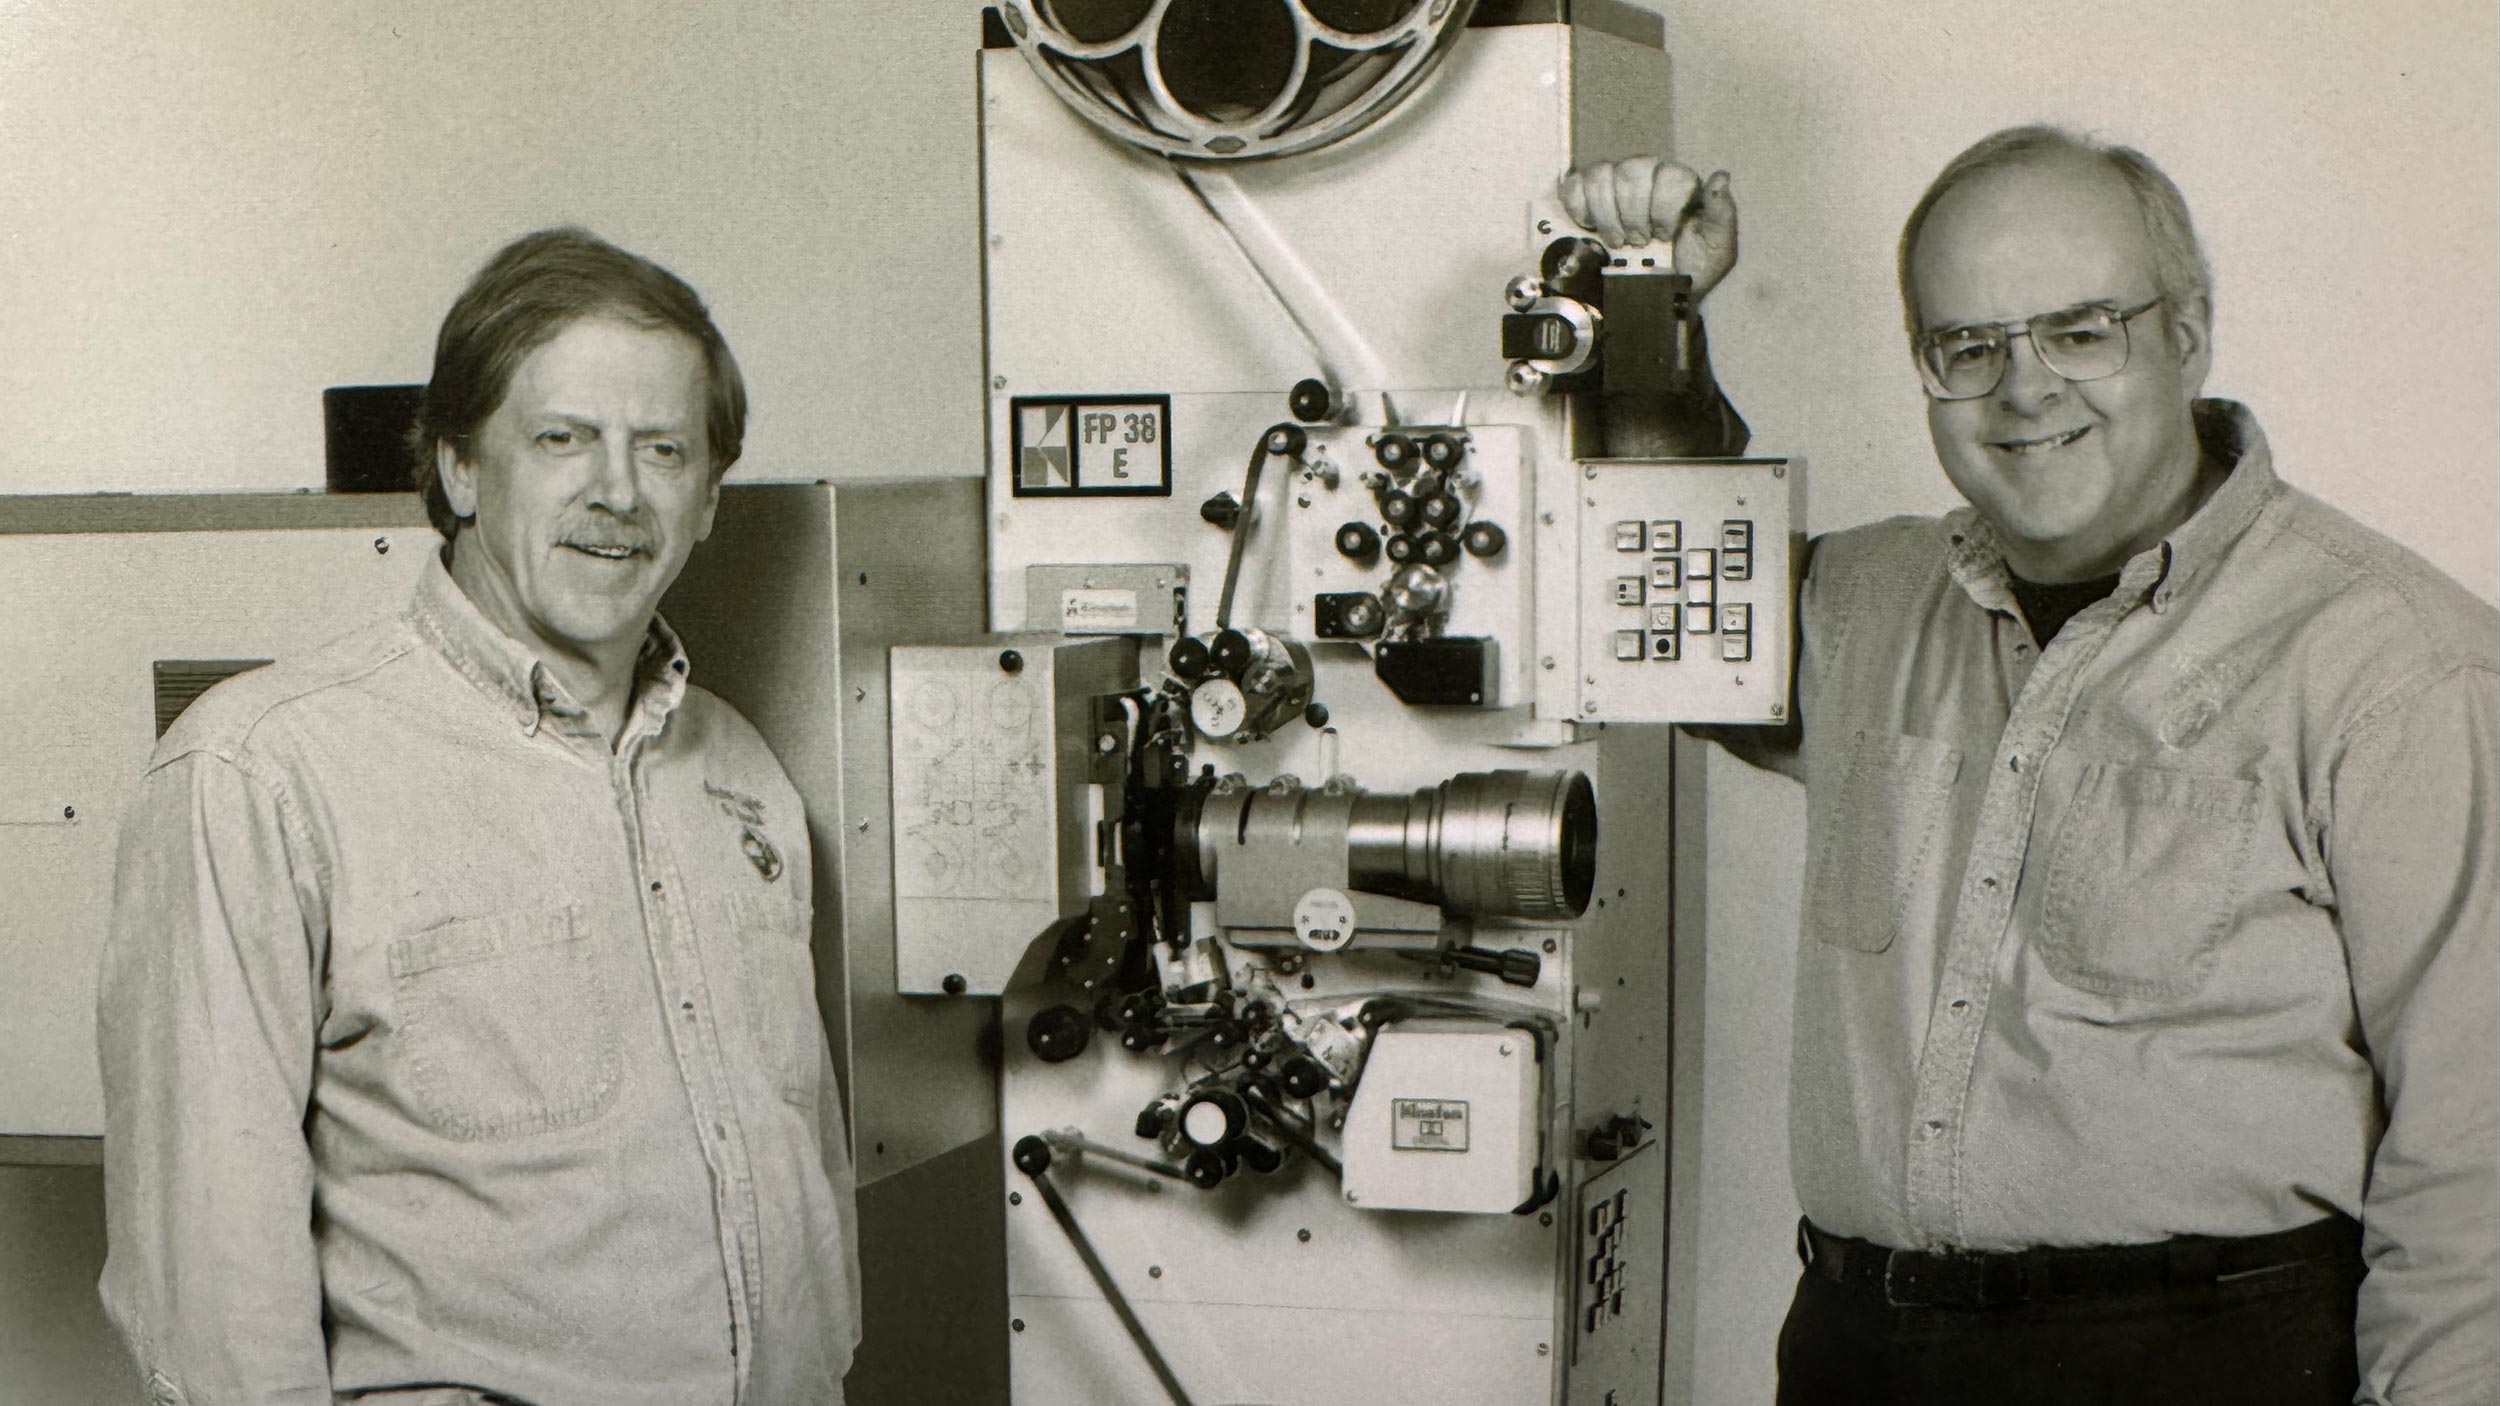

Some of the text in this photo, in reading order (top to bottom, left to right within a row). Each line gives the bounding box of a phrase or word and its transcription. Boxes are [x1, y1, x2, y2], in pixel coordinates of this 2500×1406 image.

[1084, 412, 1156, 443] FP 38
[1113, 448, 1128, 478] E
